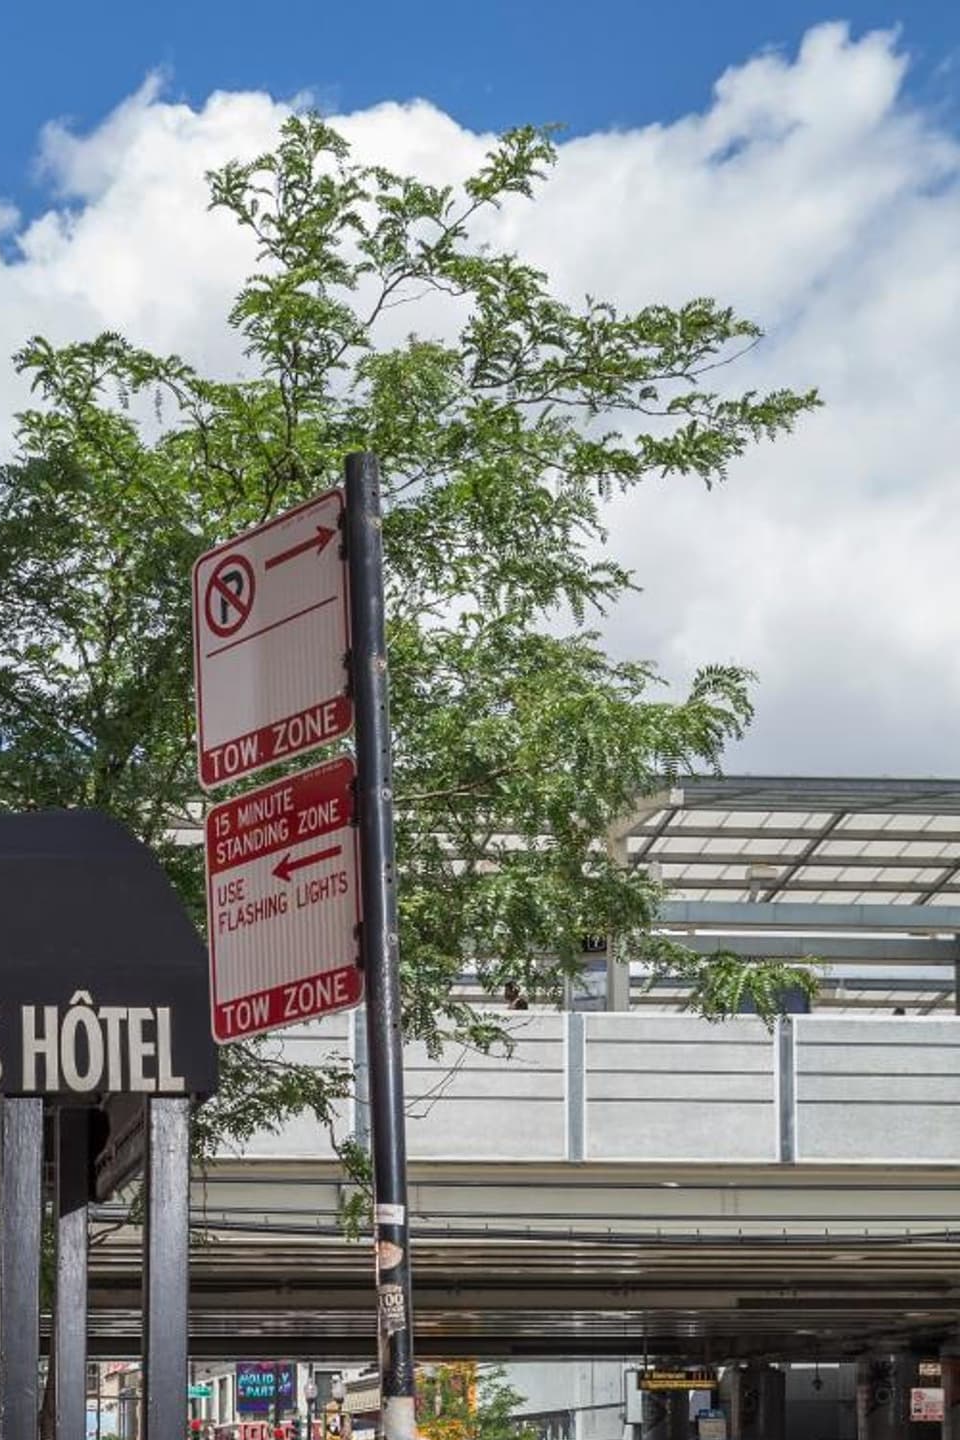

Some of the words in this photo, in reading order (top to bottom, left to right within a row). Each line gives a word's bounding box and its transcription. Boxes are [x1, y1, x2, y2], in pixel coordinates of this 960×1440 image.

[210, 736, 258, 779] TOW
[273, 702, 338, 755] ZONE
[215, 813, 231, 837] 15
[238, 787, 294, 829] MINUTE
[216, 819, 289, 864] STANDING
[297, 798, 339, 834] ZONE
[218, 879, 245, 907] USE
[219, 892, 288, 934] FLASHING
[296, 871, 348, 908] LIGHTS
[222, 996, 271, 1034] TOW
[284, 972, 349, 1017] ZONE
[21, 989, 185, 1092] HÔTEL
[239, 1372, 289, 1385] HOLIDY
